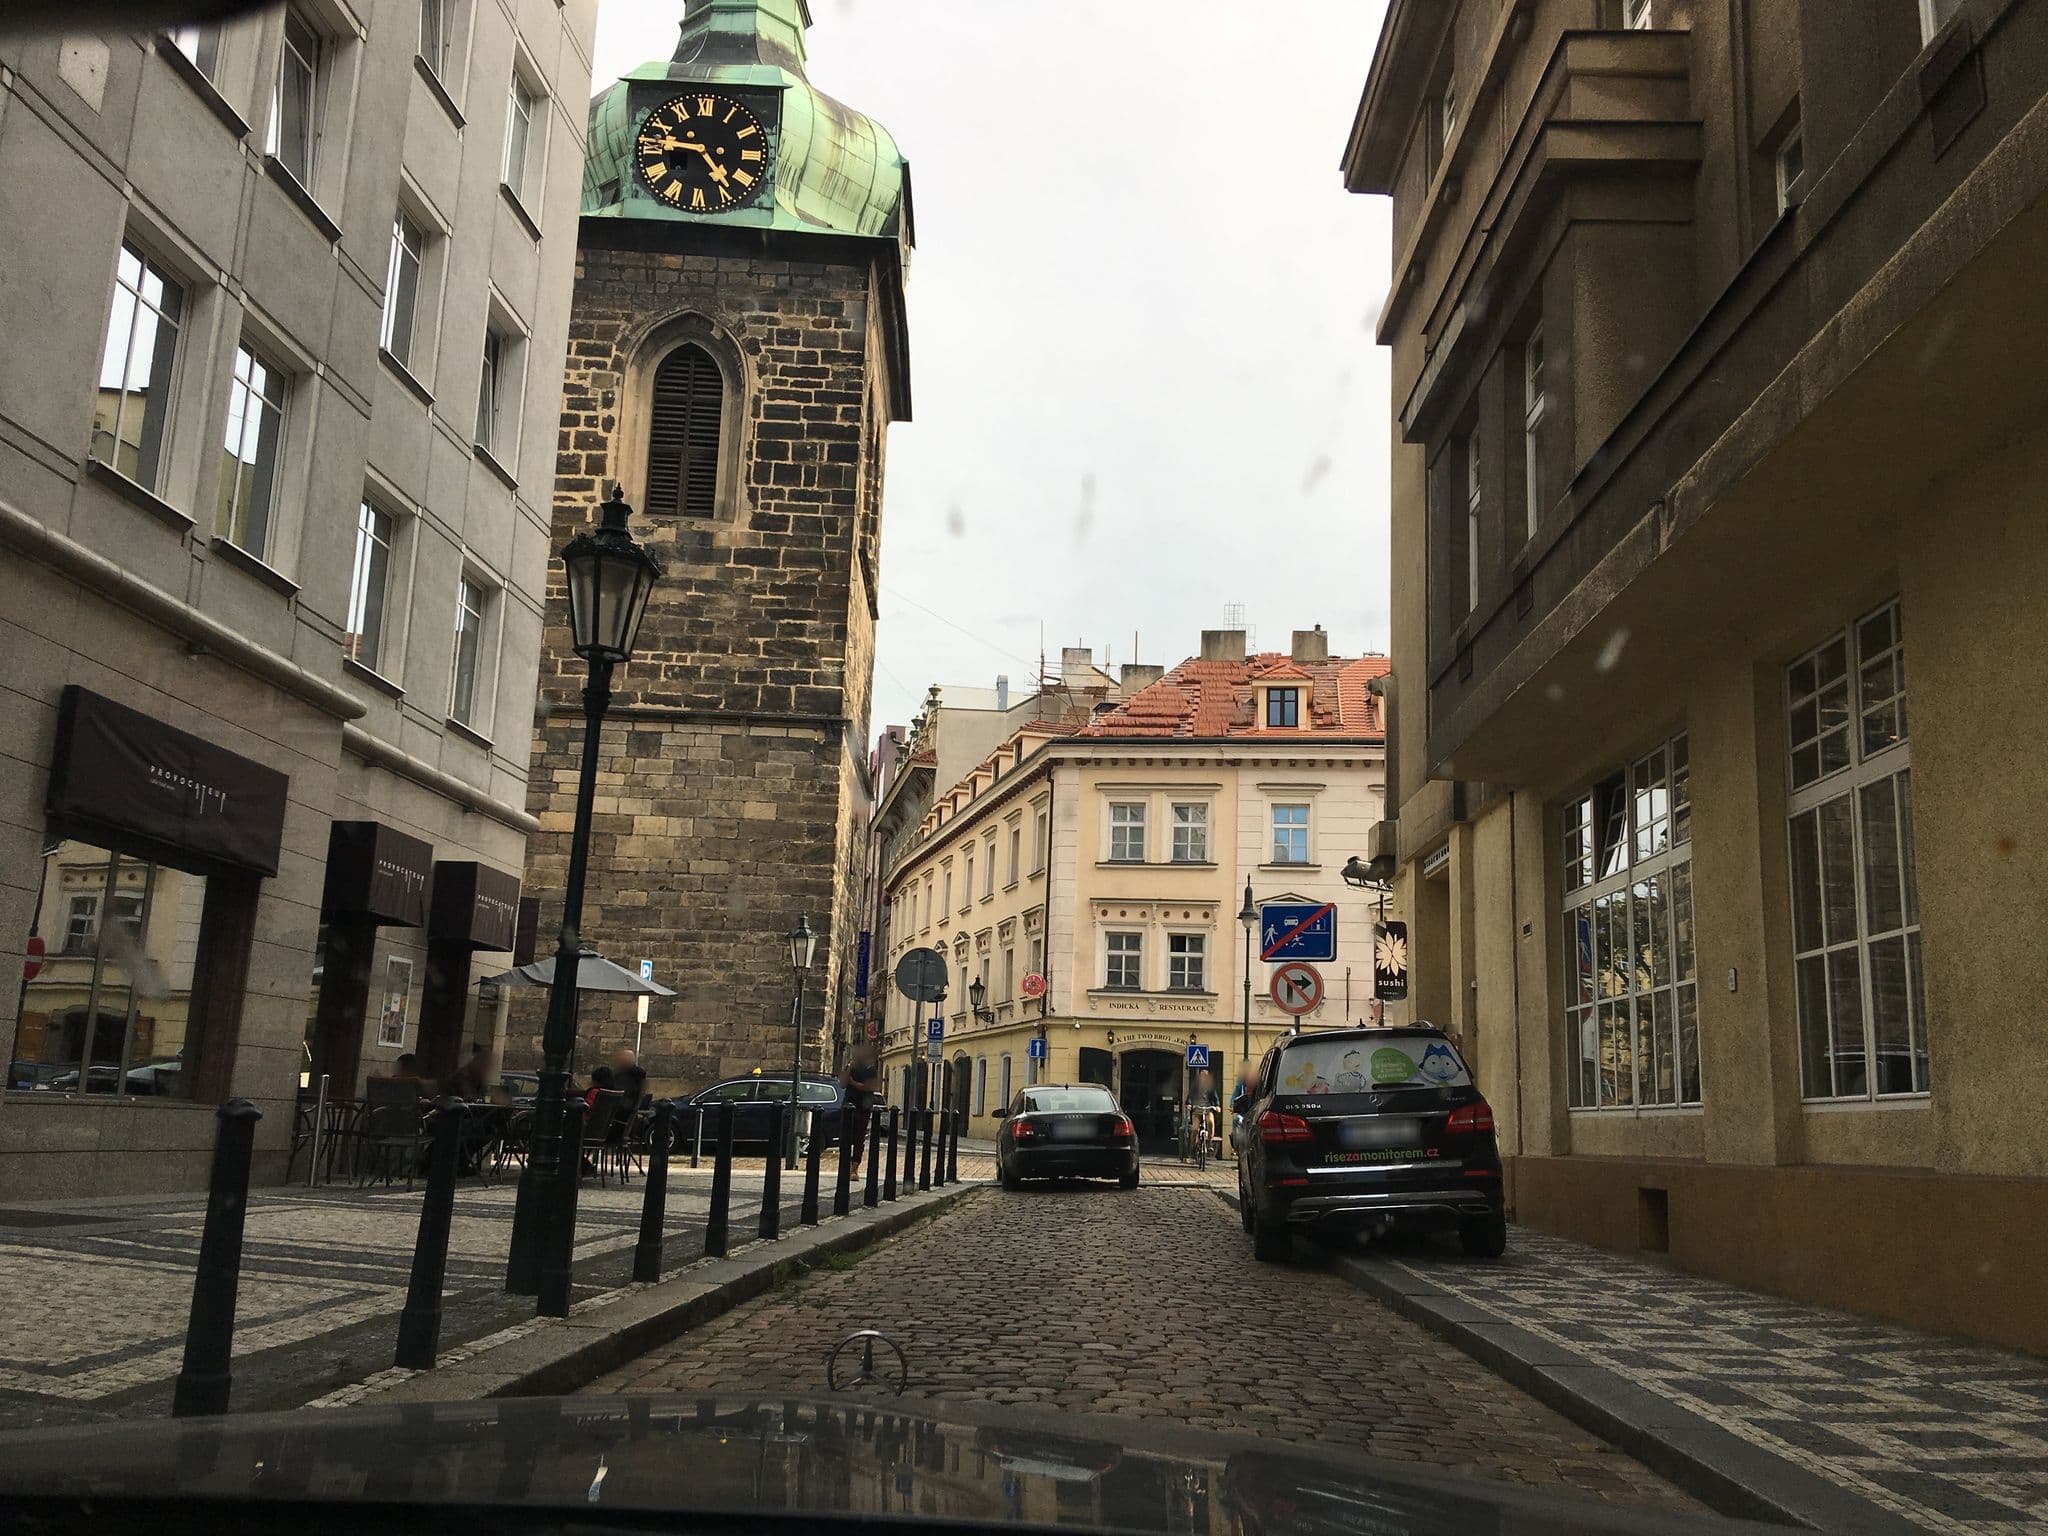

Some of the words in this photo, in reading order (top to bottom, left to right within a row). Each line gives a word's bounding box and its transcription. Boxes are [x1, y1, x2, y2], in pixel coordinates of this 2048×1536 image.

[670, 102, 690, 123] XI
[697, 98, 715, 117] XII
[723, 106, 737, 124] I
[652, 118, 673, 135] X
[736, 125, 757, 140] II
[741, 149, 761, 161] III
[663, 179, 683, 201] VII
[691, 188, 706, 207] VI
[718, 185, 733, 203] V
[150, 764, 226, 814] PROVOCATEUR
[1377, 978, 1405, 987] sushi
[1159, 1004, 1206, 1012] RESTAURACE
[931, 1021, 941, 1034] P
[1325, 1148, 1440, 1163] risezamonitorem.cz
